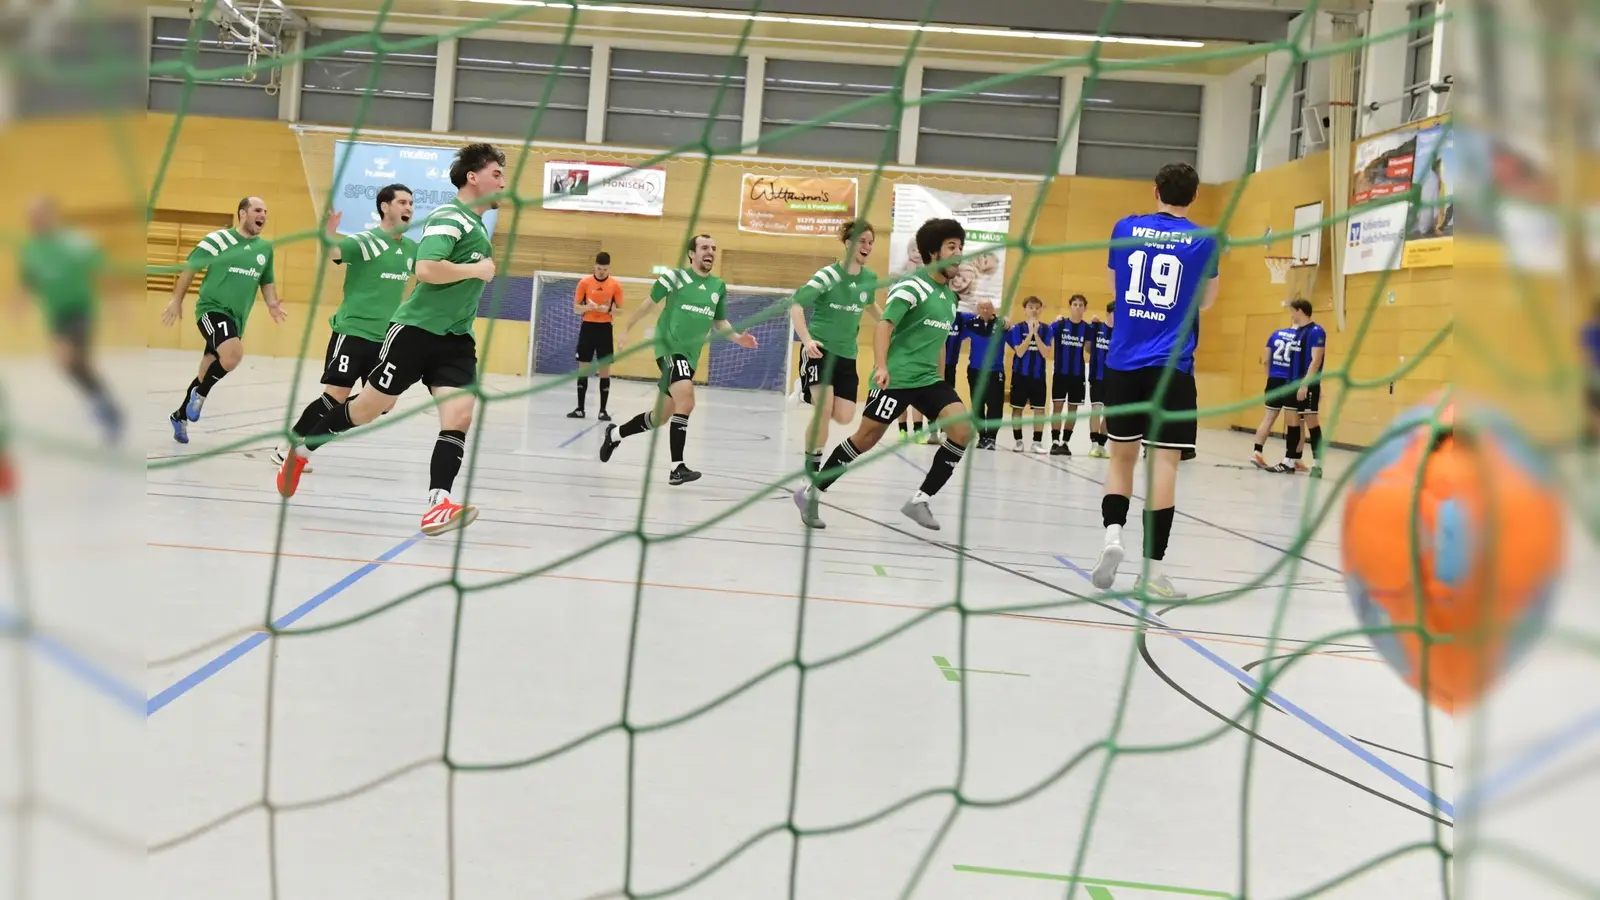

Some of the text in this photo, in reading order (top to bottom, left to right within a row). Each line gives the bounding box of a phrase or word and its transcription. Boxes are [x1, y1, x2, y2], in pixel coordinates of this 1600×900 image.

[1132, 226, 1193, 245] WEIDEN
[1125, 250, 1183, 310] 19
[1129, 308, 1166, 321] BRAND
[217, 320, 229, 336] 7
[1096, 336, 1109, 345] Urba
[338, 354, 350, 373] 8
[676, 359, 691, 377] 18
[378, 361, 397, 389] 5
[807, 364, 818, 383] 31
[874, 395, 898, 420] 19
